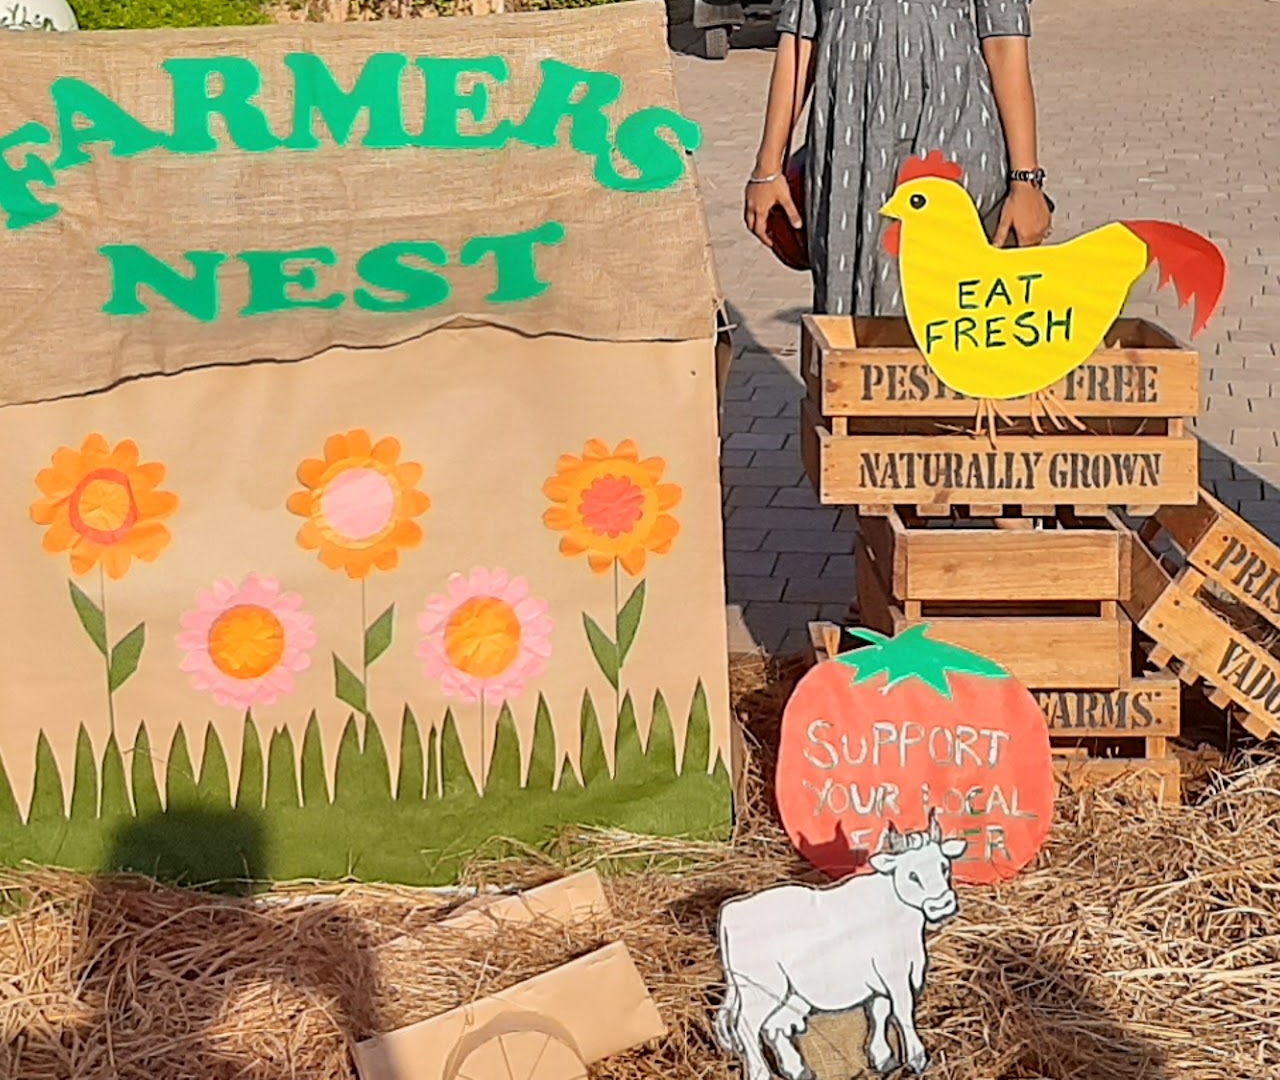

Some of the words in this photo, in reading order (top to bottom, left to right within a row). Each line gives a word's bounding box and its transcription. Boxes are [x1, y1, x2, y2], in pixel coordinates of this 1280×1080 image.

[99, 220, 566, 323] NEST
[958, 273, 1043, 311] EAT
[925, 306, 1074, 355] FRESH
[1063, 364, 1159, 403] FREE
[859, 450, 1043, 490] NATURALLY
[1048, 451, 1162, 489] GROWN
[802, 718, 1011, 770] SUPPORT
[801, 777, 902, 818] YOUR
[920, 782, 1039, 818] LOCAL
